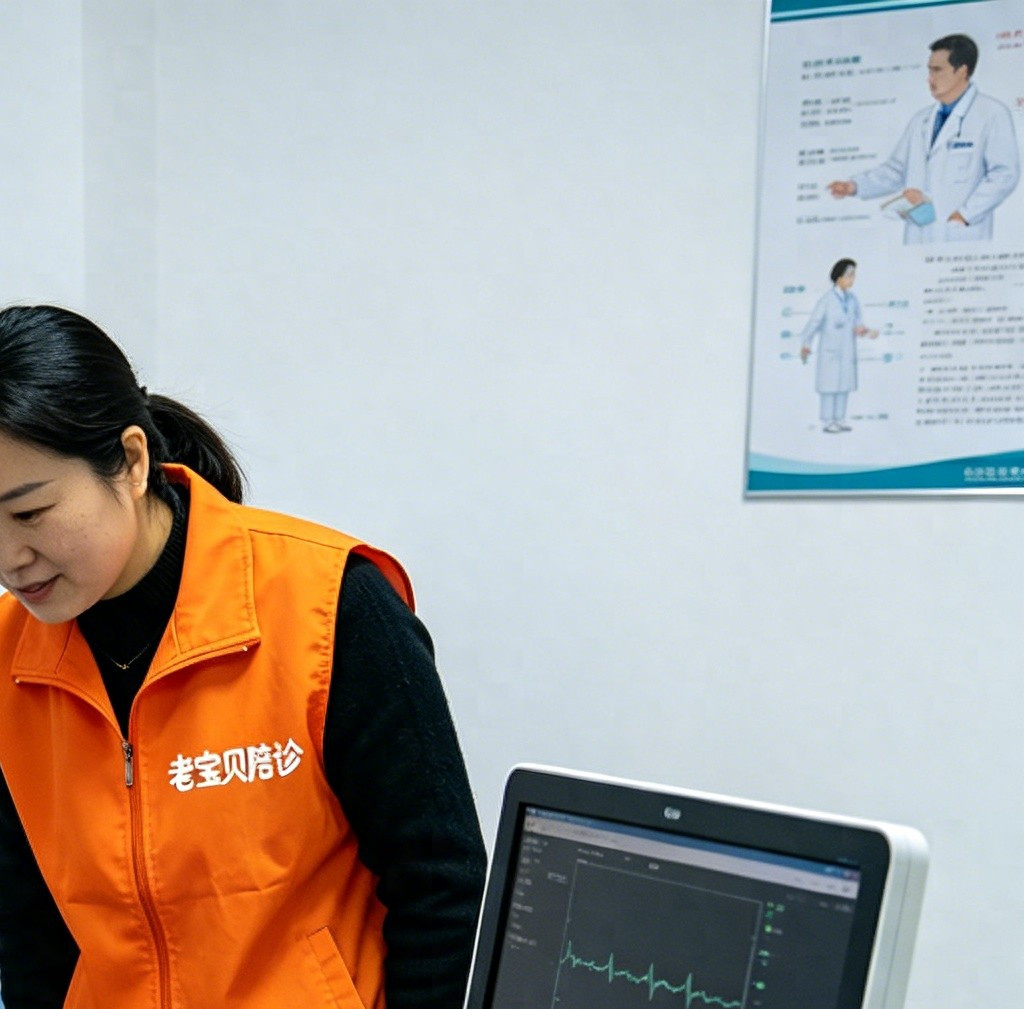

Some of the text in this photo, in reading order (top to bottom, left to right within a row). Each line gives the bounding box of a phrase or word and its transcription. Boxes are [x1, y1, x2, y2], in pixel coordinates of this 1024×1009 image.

[168, 738, 304, 792] 老宝贝陪诊
